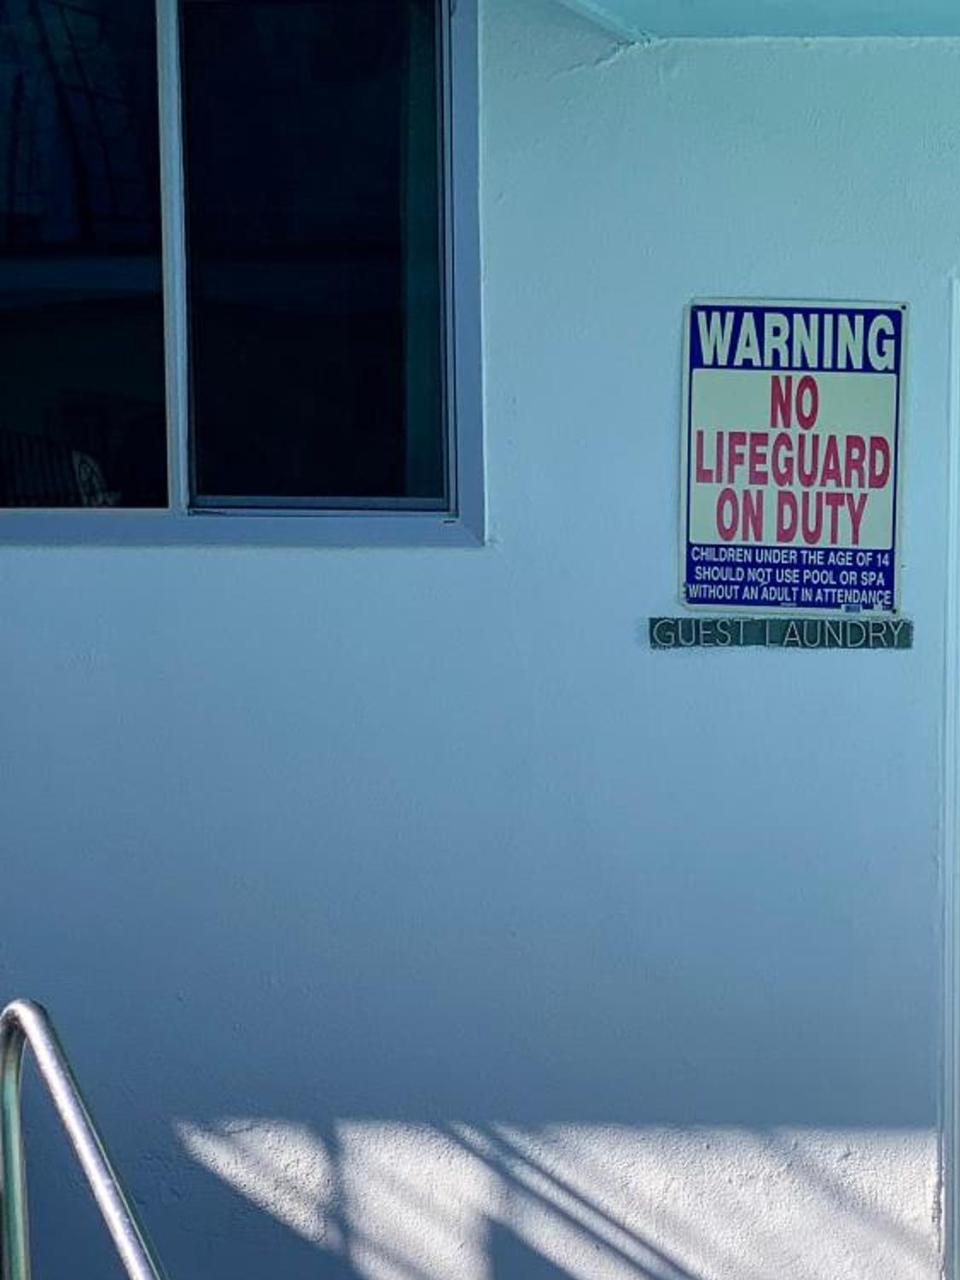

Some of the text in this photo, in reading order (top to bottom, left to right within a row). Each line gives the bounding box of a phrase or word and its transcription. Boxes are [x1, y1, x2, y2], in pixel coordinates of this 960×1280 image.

[697, 311, 896, 371] WARNING
[770, 375, 819, 430] NO
[696, 430, 890, 489] LIFEGUARD
[716, 488, 869, 546] ON DUTY
[691, 547, 889, 567] CHILDREN UNDER THE AGE OF 14
[695, 566, 885, 586] SHOULD NOT USE POOL OR SPA
[688, 584, 891, 605] WITHOUT AN ADULT IN ATTENDANCE
[652, 619, 905, 647] GUEST LAUNDRY
